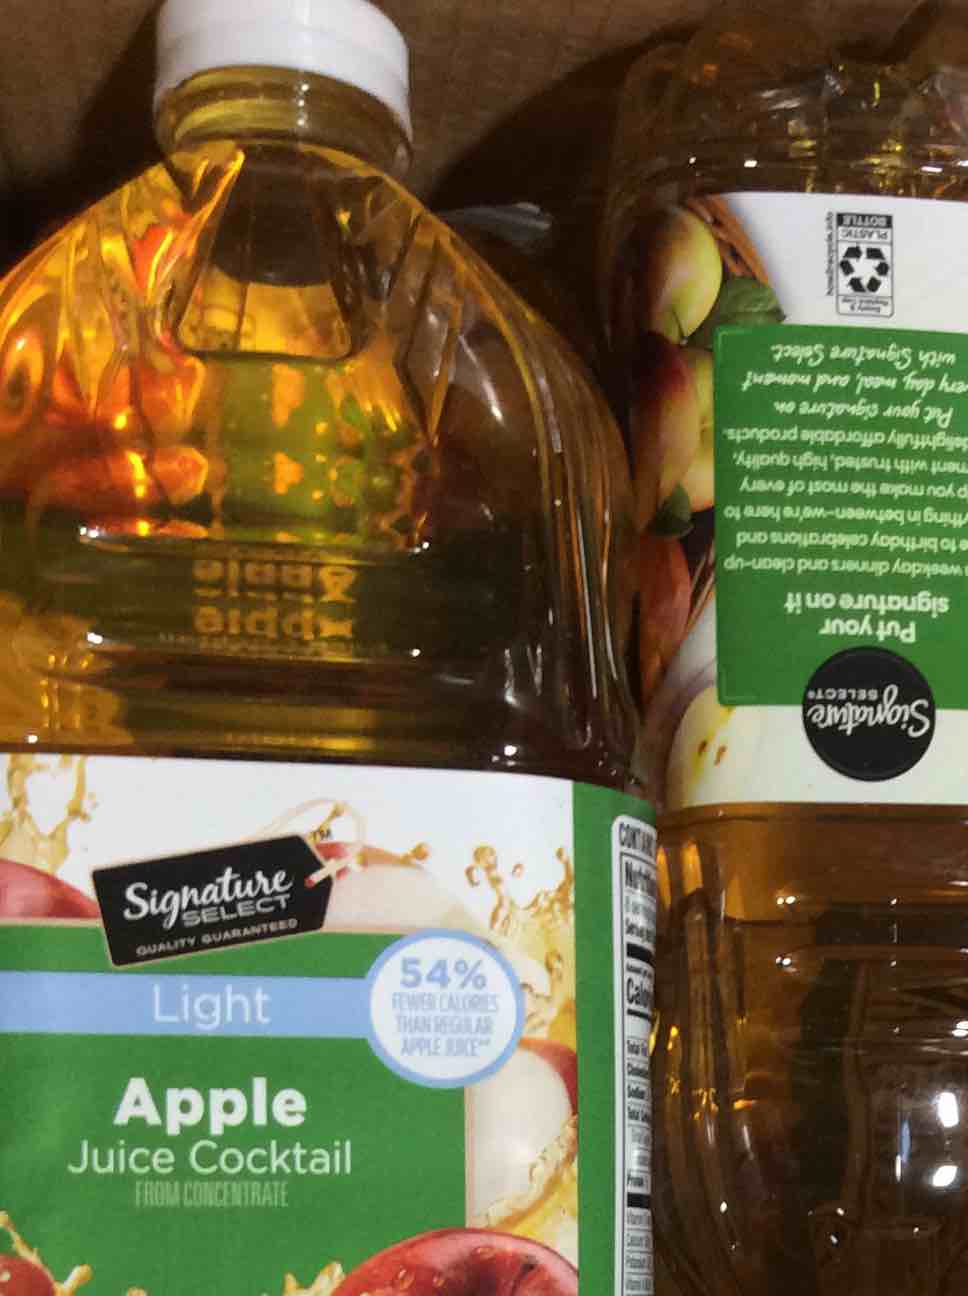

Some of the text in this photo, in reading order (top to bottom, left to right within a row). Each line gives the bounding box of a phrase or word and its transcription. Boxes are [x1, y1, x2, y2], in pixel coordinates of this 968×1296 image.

[830, 344, 912, 370] Signature
[919, 350, 956, 368] with
[741, 371, 810, 391] moment
[813, 374, 850, 393] and
[774, 399, 953, 428] Put your signature on
[802, 429, 885, 447] affordable
[793, 454, 827, 471] high
[894, 458, 928, 473] with
[739, 479, 784, 493] every
[786, 480, 805, 496] of
[808, 480, 850, 496] most
[852, 482, 877, 498] the
[879, 483, 925, 498] make
[926, 485, 956, 501] you
[724, 507, 741, 520] to
[744, 505, 781, 520] here
[908, 510, 922, 527] in
[735, 530, 768, 548] and
[769, 530, 869, 547] celebrations
[873, 532, 939, 553] birthday
[940, 539, 957, 553] to
[724, 554, 795, 573] clean-up
[796, 557, 829, 573] and
[832, 559, 890, 576] dinners
[892, 557, 962, 578] weekday
[784, 590, 950, 618] signature on it
[818, 615, 916, 643] Put your
[806, 684, 931, 738] Signature
[123, 866, 294, 930] Signature
[182, 894, 290, 928] SELECT
[136, 918, 298, 957] QUALITY GUARANTEED
[399, 957, 487, 990] 54%
[152, 982, 271, 1031] Light
[392, 993, 498, 1013] FEWER CALORIES
[397, 1015, 493, 1035] THAN REGULAR
[401, 1036, 442, 1056] APPLE
[113, 1077, 307, 1135] Apple
[67, 1139, 351, 1174] Juice Cocktail
[135, 1180, 288, 1206] FROM CONCENTRATE
